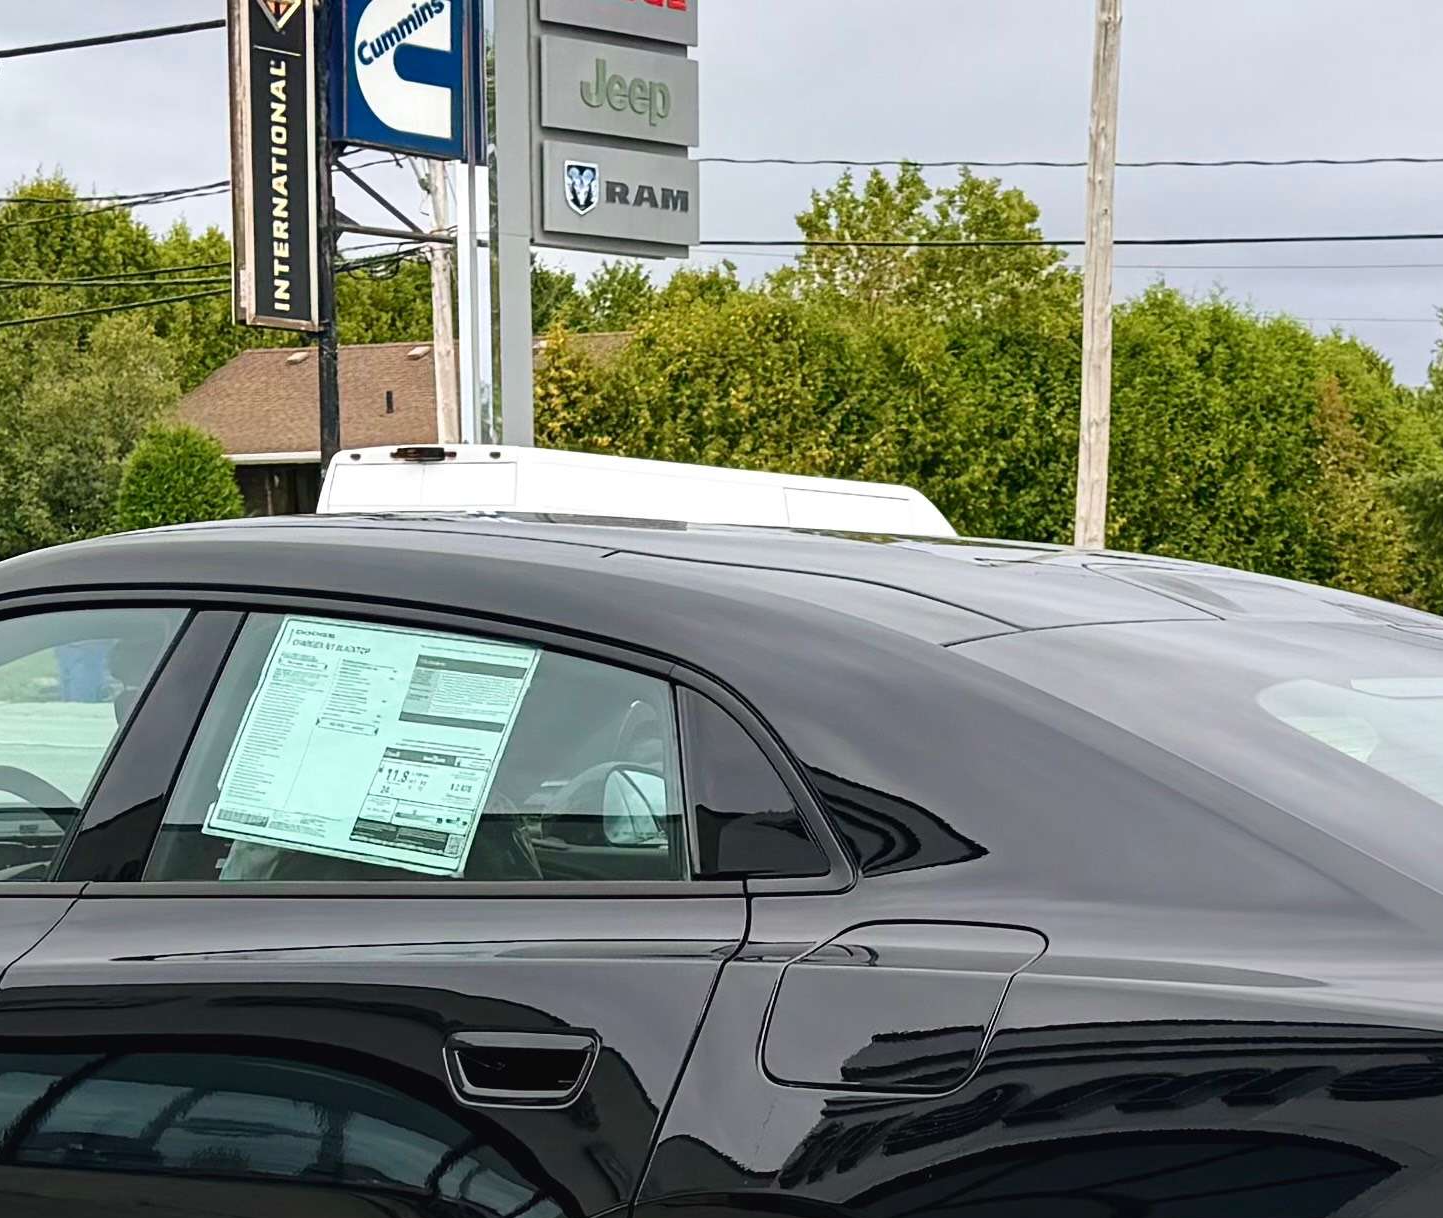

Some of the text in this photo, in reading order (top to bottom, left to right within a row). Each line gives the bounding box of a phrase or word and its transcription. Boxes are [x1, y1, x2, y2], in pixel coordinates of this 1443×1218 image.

[357, 0, 445, 65] Cummins
[580, 58, 671, 127] Jeep
[269, 60, 290, 312] INTERNATIONAL
[605, 181, 689, 213] RAM
